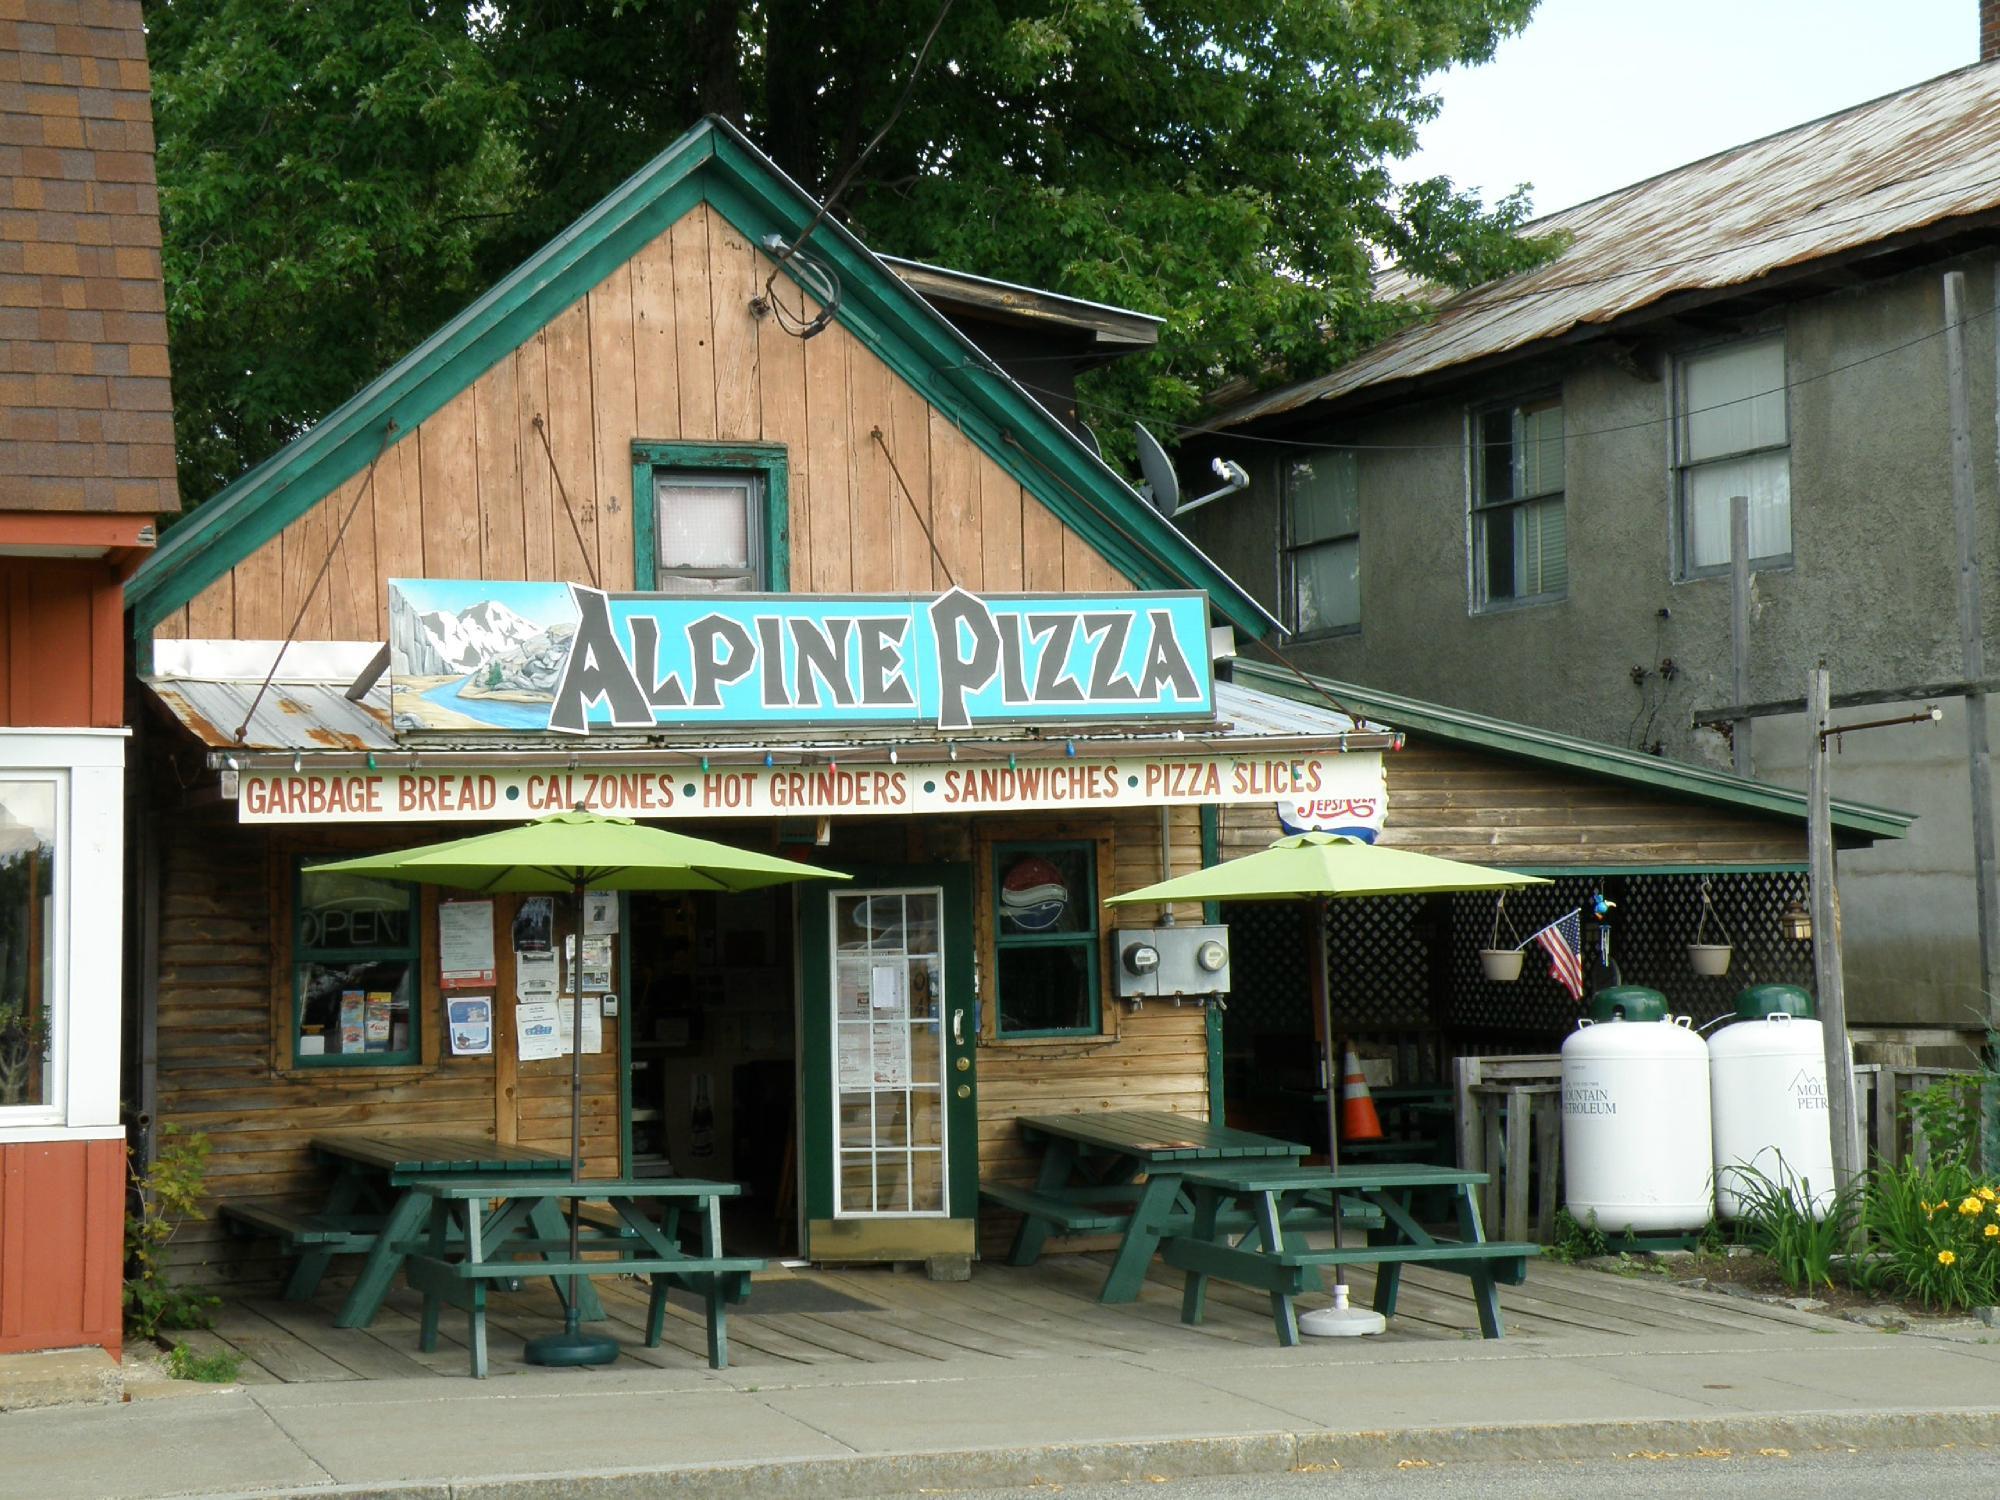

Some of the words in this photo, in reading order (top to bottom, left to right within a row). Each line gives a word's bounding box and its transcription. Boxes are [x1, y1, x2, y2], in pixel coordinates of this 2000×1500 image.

[547, 581, 917, 735] ALPINE
[928, 586, 1203, 730] PIZZA
[247, 776, 383, 814] GARBAGE
[400, 774, 496, 810] BREAD
[527, 773, 674, 809] CALZONES
[703, 772, 758, 807] HOT
[770, 770, 907, 806] GRINDERS
[945, 765, 1120, 803] SANDWICHES
[1145, 763, 1222, 798] PIZZA
[1233, 760, 1322, 795] SLICES
[1563, 1102, 1617, 1115] ETROLEUM
[1565, 1089, 1608, 1102] OUNTAIN
